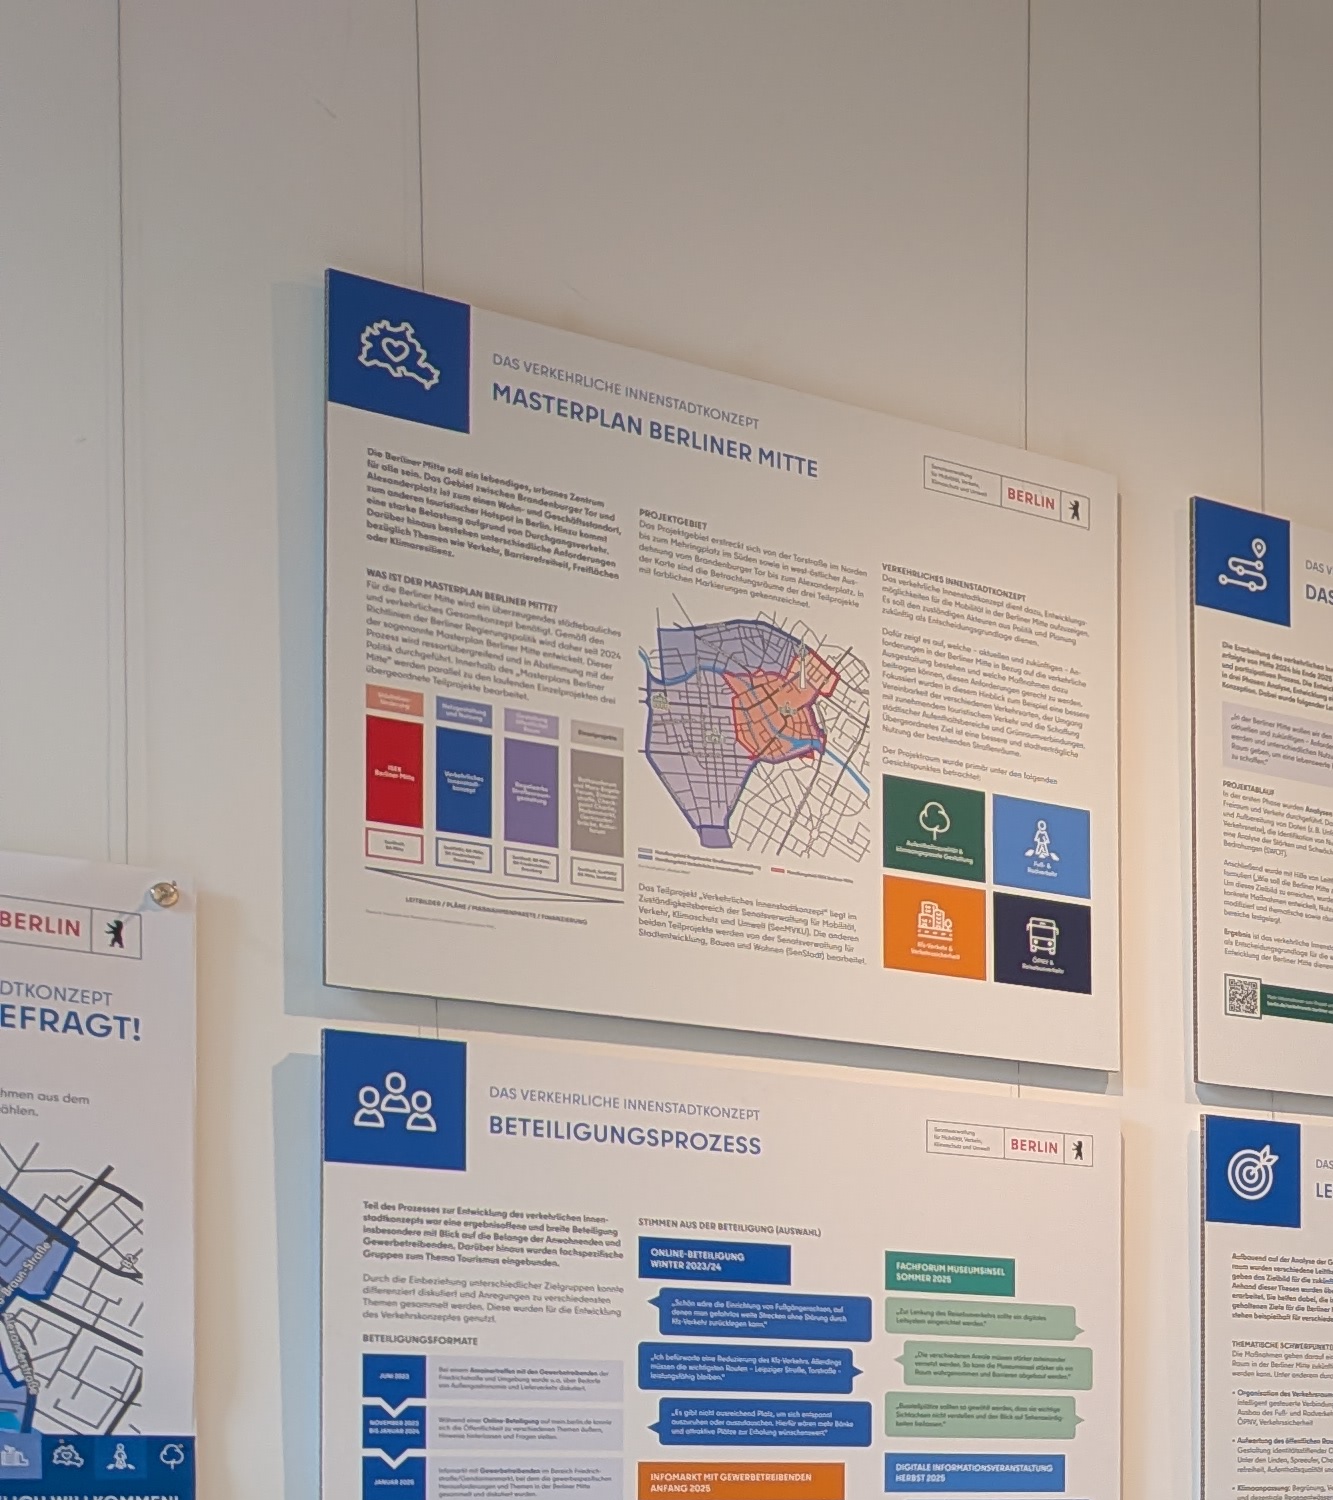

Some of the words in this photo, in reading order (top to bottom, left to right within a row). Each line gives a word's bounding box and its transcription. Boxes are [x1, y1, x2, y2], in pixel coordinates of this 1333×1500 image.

[492, 353, 520, 370] DAS
[523, 360, 621, 395] VERKEHRLICHE
[625, 386, 759, 429] INNENSTADTKONZEPT
[493, 382, 642, 435] MASTERPLAN
[649, 420, 751, 462] BERLINER
[758, 447, 817, 477] MITTE
[1007, 487, 1054, 510] BERLIN
[639, 508, 707, 530] PROJEKTGEBIET
[1305, 559, 1324, 573] DAS
[881, 562, 944, 583] VERKEHRLICHES
[945, 577, 1026, 601] INNENSTADTKONZEPT
[0, 911, 80, 937] BERLIN
[37, 1092, 59, 1102] aus
[62, 1093, 90, 1105] dem
[489, 1085, 516, 1099] DAS
[520, 1088, 619, 1108] VERKEHRLICHE
[623, 1098, 759, 1120] INNENSTADTKONZEPT
[0, 1105, 38, 1117] ählen.
[489, 1115, 761, 1154] BETEILIGUNGSPROZESS
[1011, 1138, 1057, 1154] BERLIN
[1316, 1158, 1333, 1169] DAS
[638, 1217, 678, 1228] STIMMEN
[679, 1220, 697, 1229] AUS
[699, 1221, 716, 1230] DER
[717, 1222, 774, 1233] BETEILIGUNG
[775, 1225, 821, 1237] (AUSWAHL)
[650, 1247, 744, 1261] ONLINE-BETEILIGUNG
[650, 1259, 684, 1269] WINTER
[685, 1261, 721, 1271] 2023/24
[896, 1261, 946, 1272] FACHFORUM
[947, 1265, 1005, 1276] MUSEUMSINSEL
[896, 1272, 931, 1281] SOMMER
[932, 1274, 951, 1283] 2025
[362, 1333, 477, 1345] BETEILIGUNGSFORMATE
[650, 1472, 702, 1481] INFOMARKT
[703, 1473, 718, 1481] MIT
[719, 1473, 811, 1481] GEWERBETREIBENDEN
[650, 1484, 688, 1492] ANFANG
[689, 1484, 711, 1492] 2025
